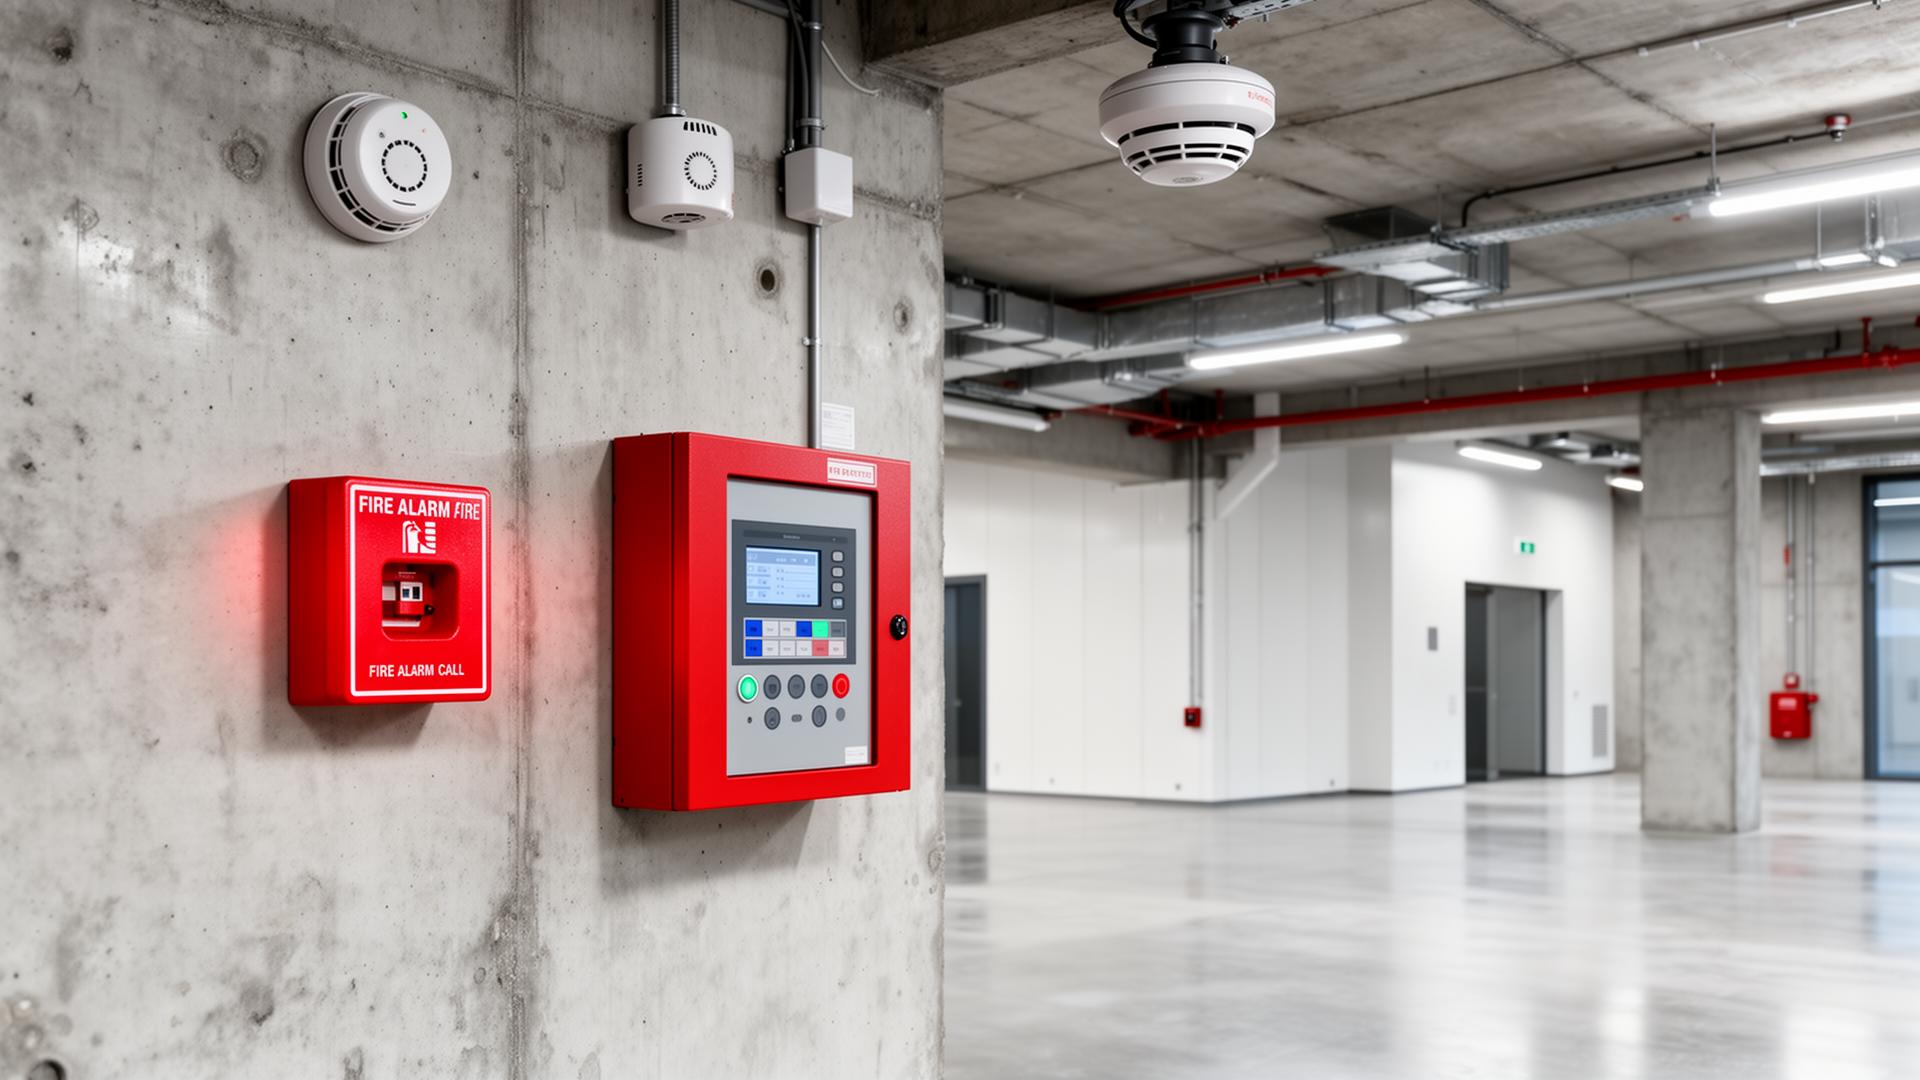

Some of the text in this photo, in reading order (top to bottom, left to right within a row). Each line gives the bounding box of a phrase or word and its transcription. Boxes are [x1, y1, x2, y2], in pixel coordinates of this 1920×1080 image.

[359, 496, 393, 515] FIRE
[397, 498, 450, 518] ALARM
[369, 663, 464, 678] FIRE ALARM CALL
